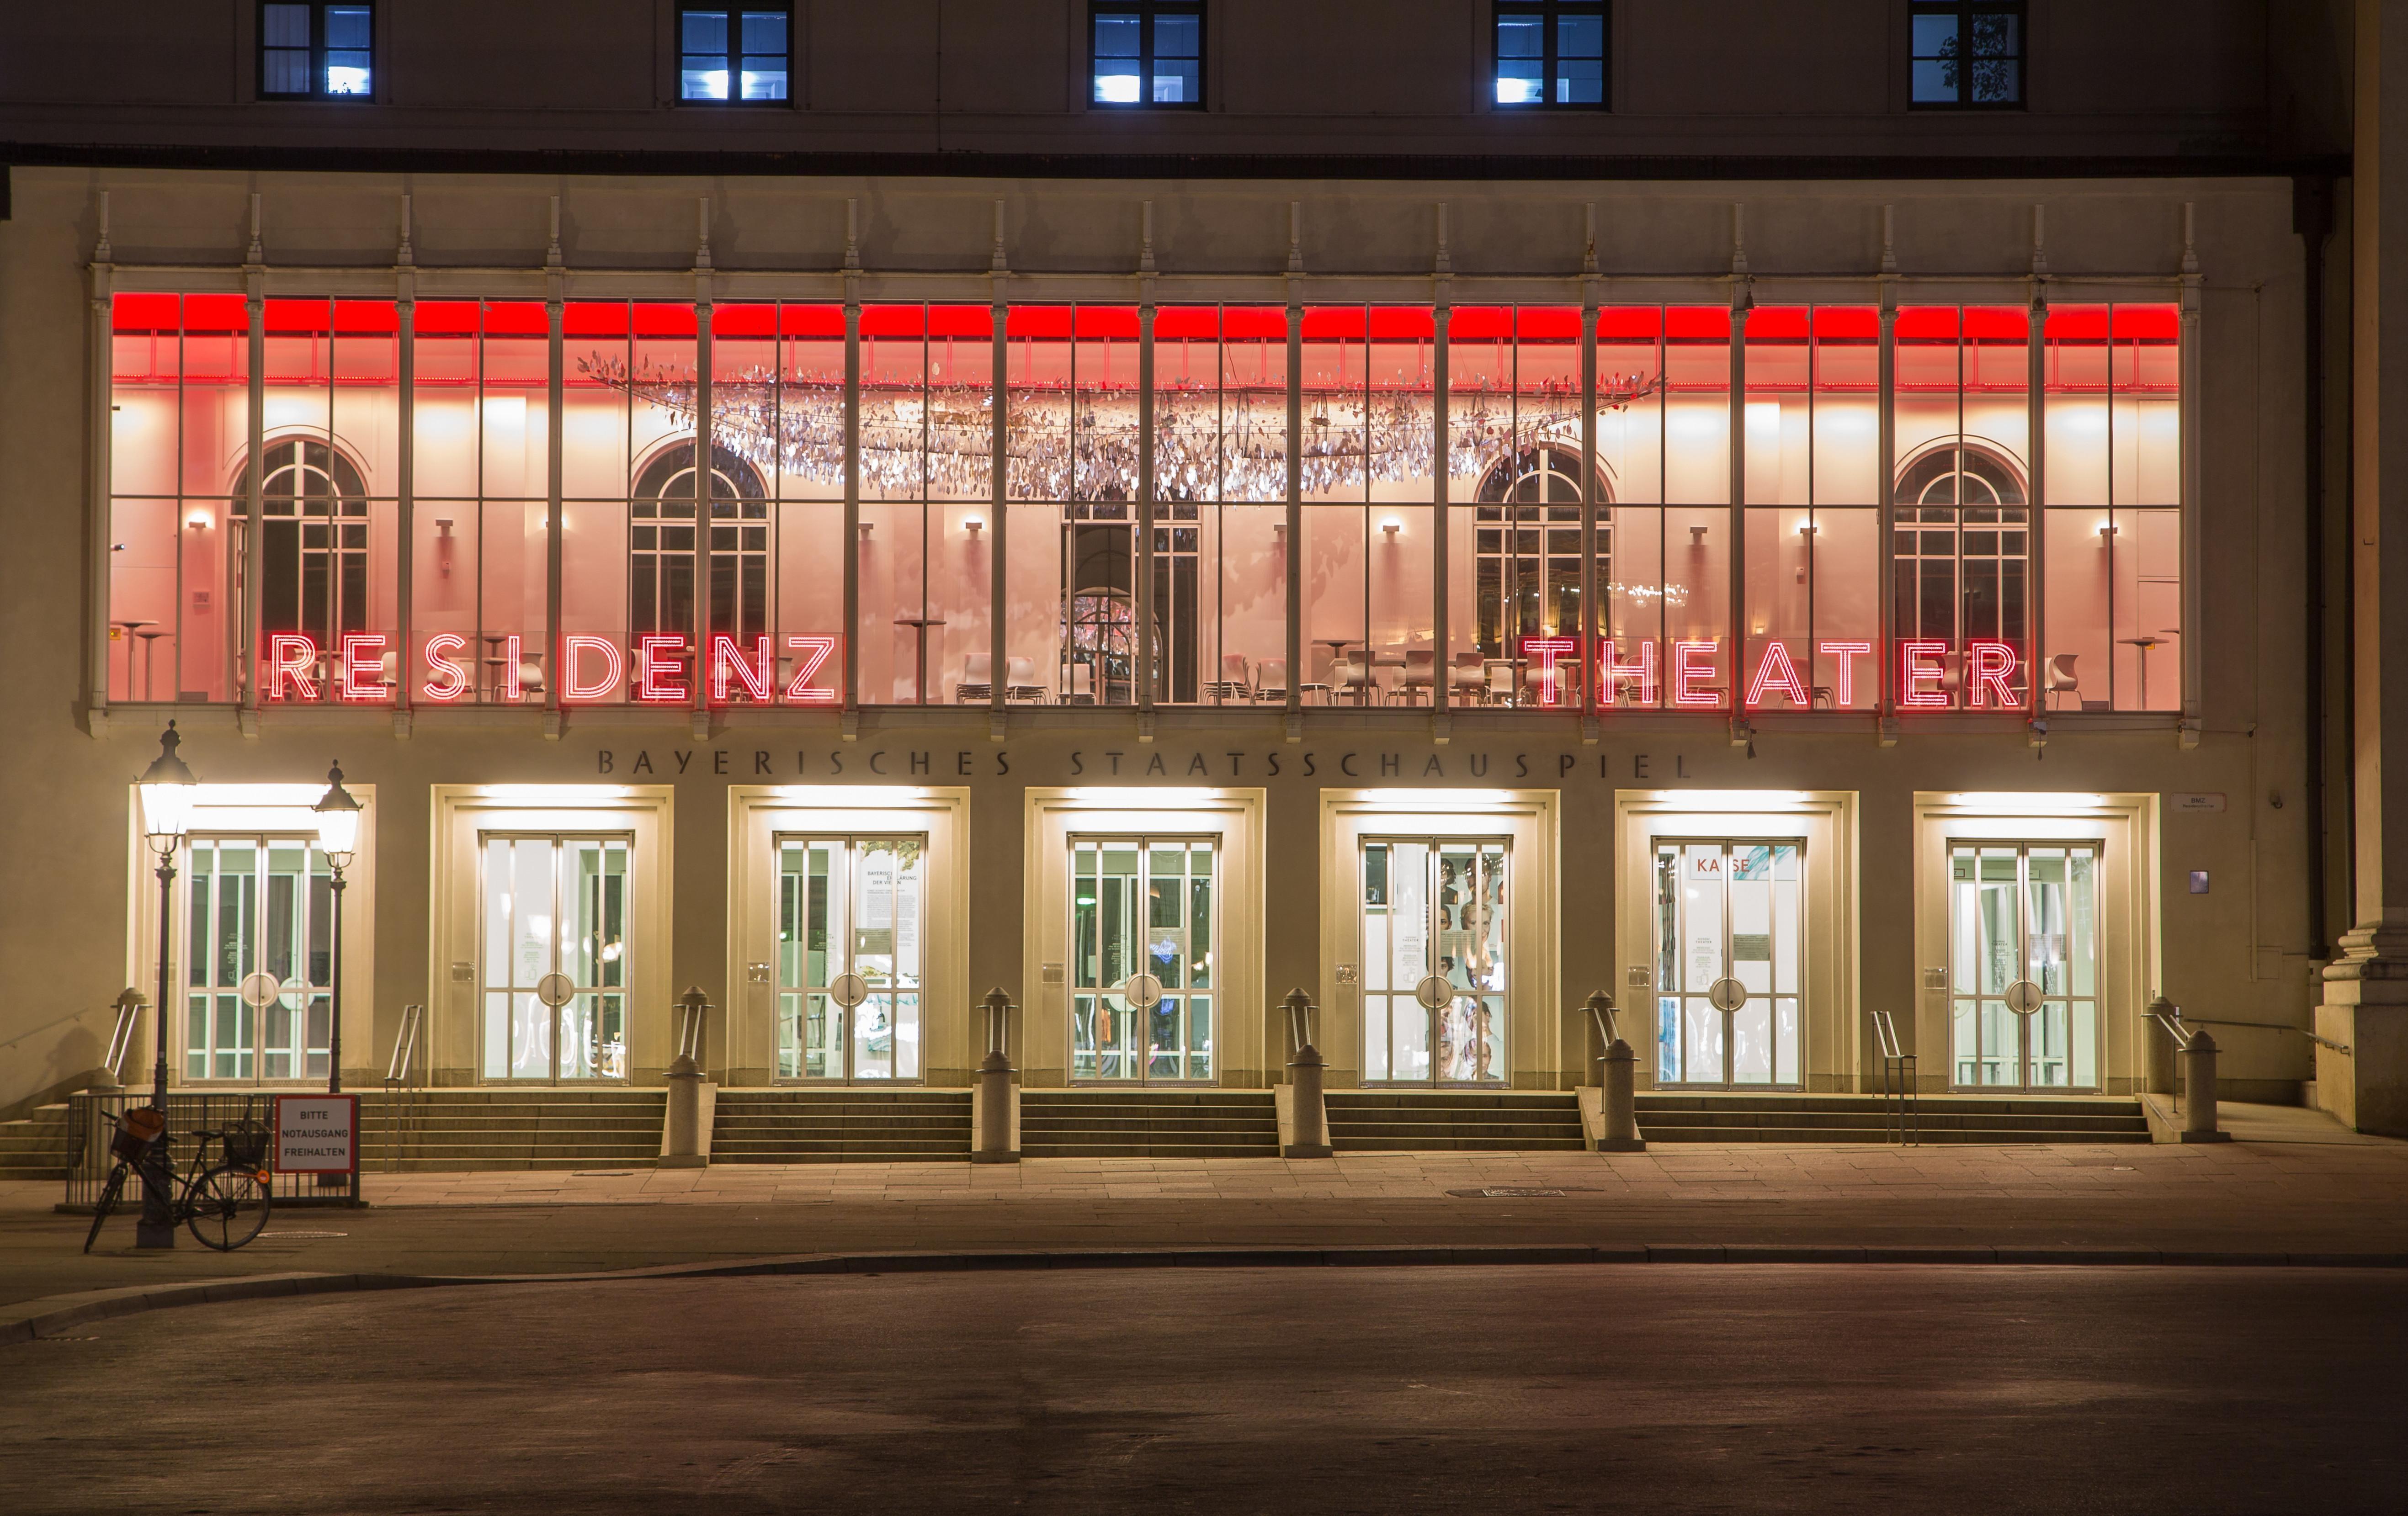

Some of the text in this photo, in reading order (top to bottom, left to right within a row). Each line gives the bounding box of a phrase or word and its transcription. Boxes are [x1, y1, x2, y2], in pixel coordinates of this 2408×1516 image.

[271, 634, 2019, 706] RESIDENZ THEATER
[598, 750, 1690, 779] BAYERISCHES STAATSSCHAUSPIEL
[1697, 859, 1750, 872] KASE
[300, 1111, 329, 1119] BITTE
[282, 1129, 348, 1138] NOTAUSGANG
[284, 1148, 346, 1156] FREIHALTEN
